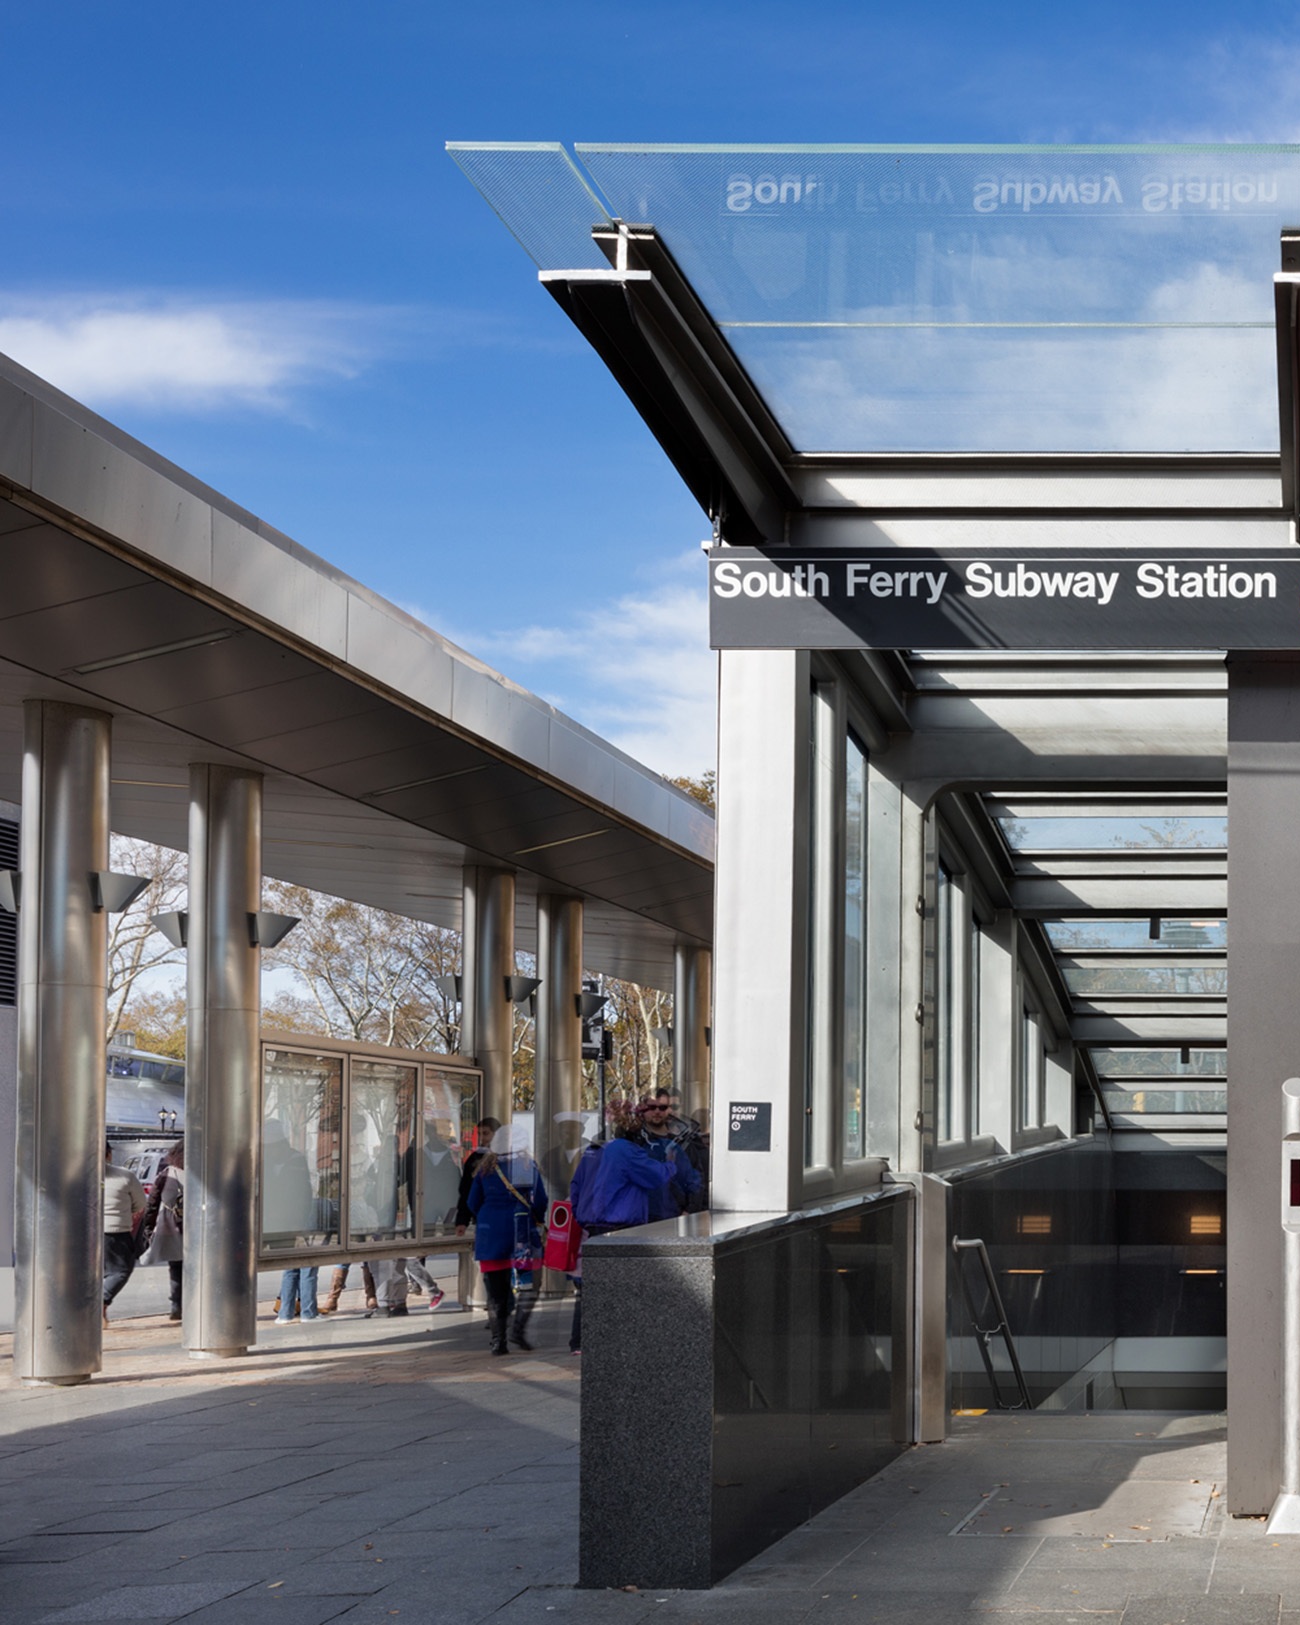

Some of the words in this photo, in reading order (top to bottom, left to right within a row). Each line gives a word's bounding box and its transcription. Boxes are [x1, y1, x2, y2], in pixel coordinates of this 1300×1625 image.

[713, 562, 830, 599] South
[845, 563, 949, 604] Ferry
[964, 562, 1120, 605] Subway
[1136, 562, 1278, 600] Station
[731, 1106, 758, 1114] SOUTH
[731, 1113, 757, 1121] FERRY
